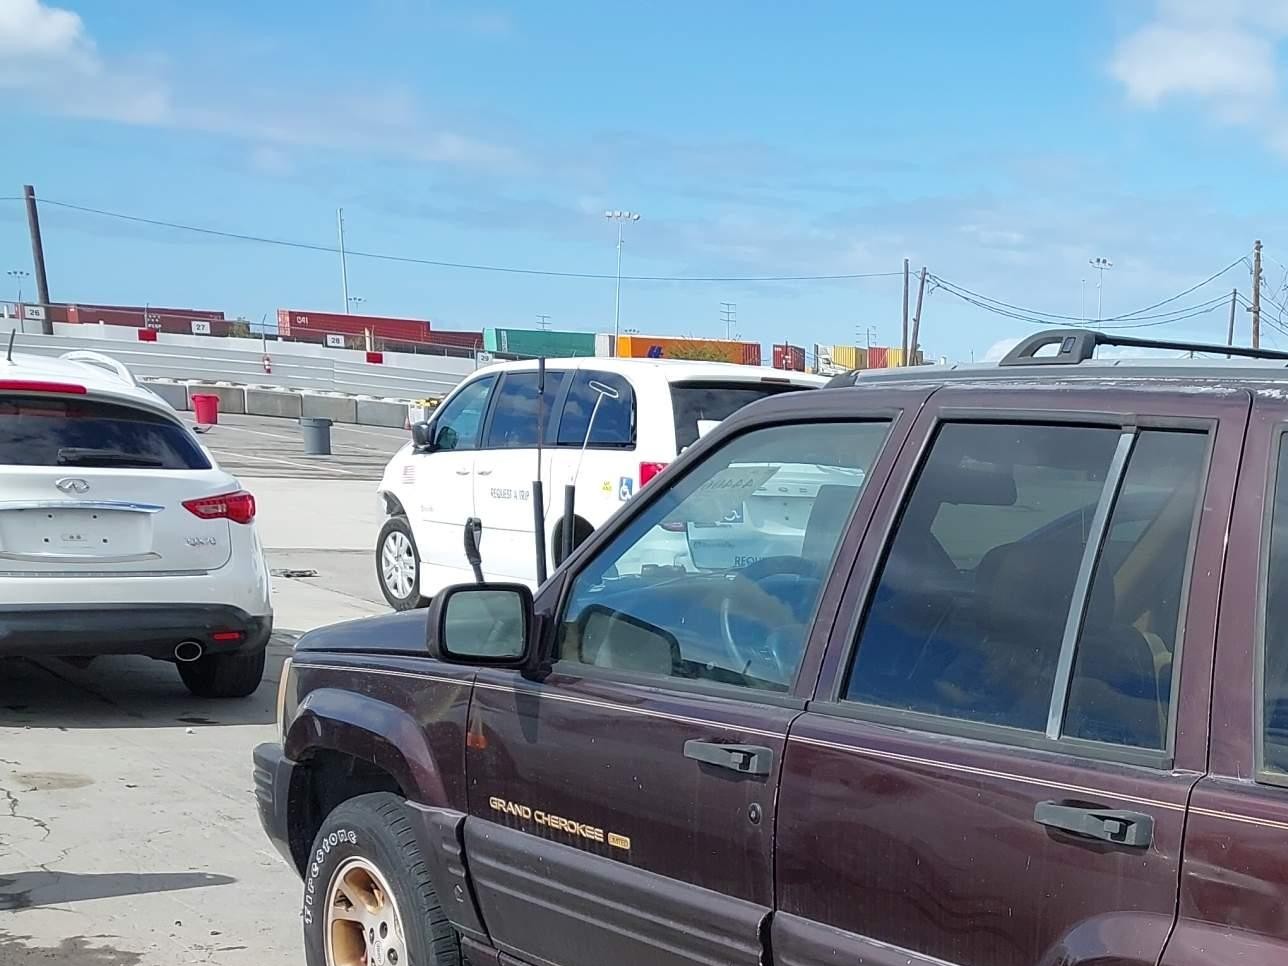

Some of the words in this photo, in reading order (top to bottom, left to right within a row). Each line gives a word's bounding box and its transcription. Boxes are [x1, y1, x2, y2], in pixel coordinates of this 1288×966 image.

[195, 323, 206, 331] 27
[490, 487, 512, 498] REQUEST
[489, 796, 532, 820] GRAND
[533, 809, 605, 843] CHEROKEE
[304, 829, 357, 925] Firestone
